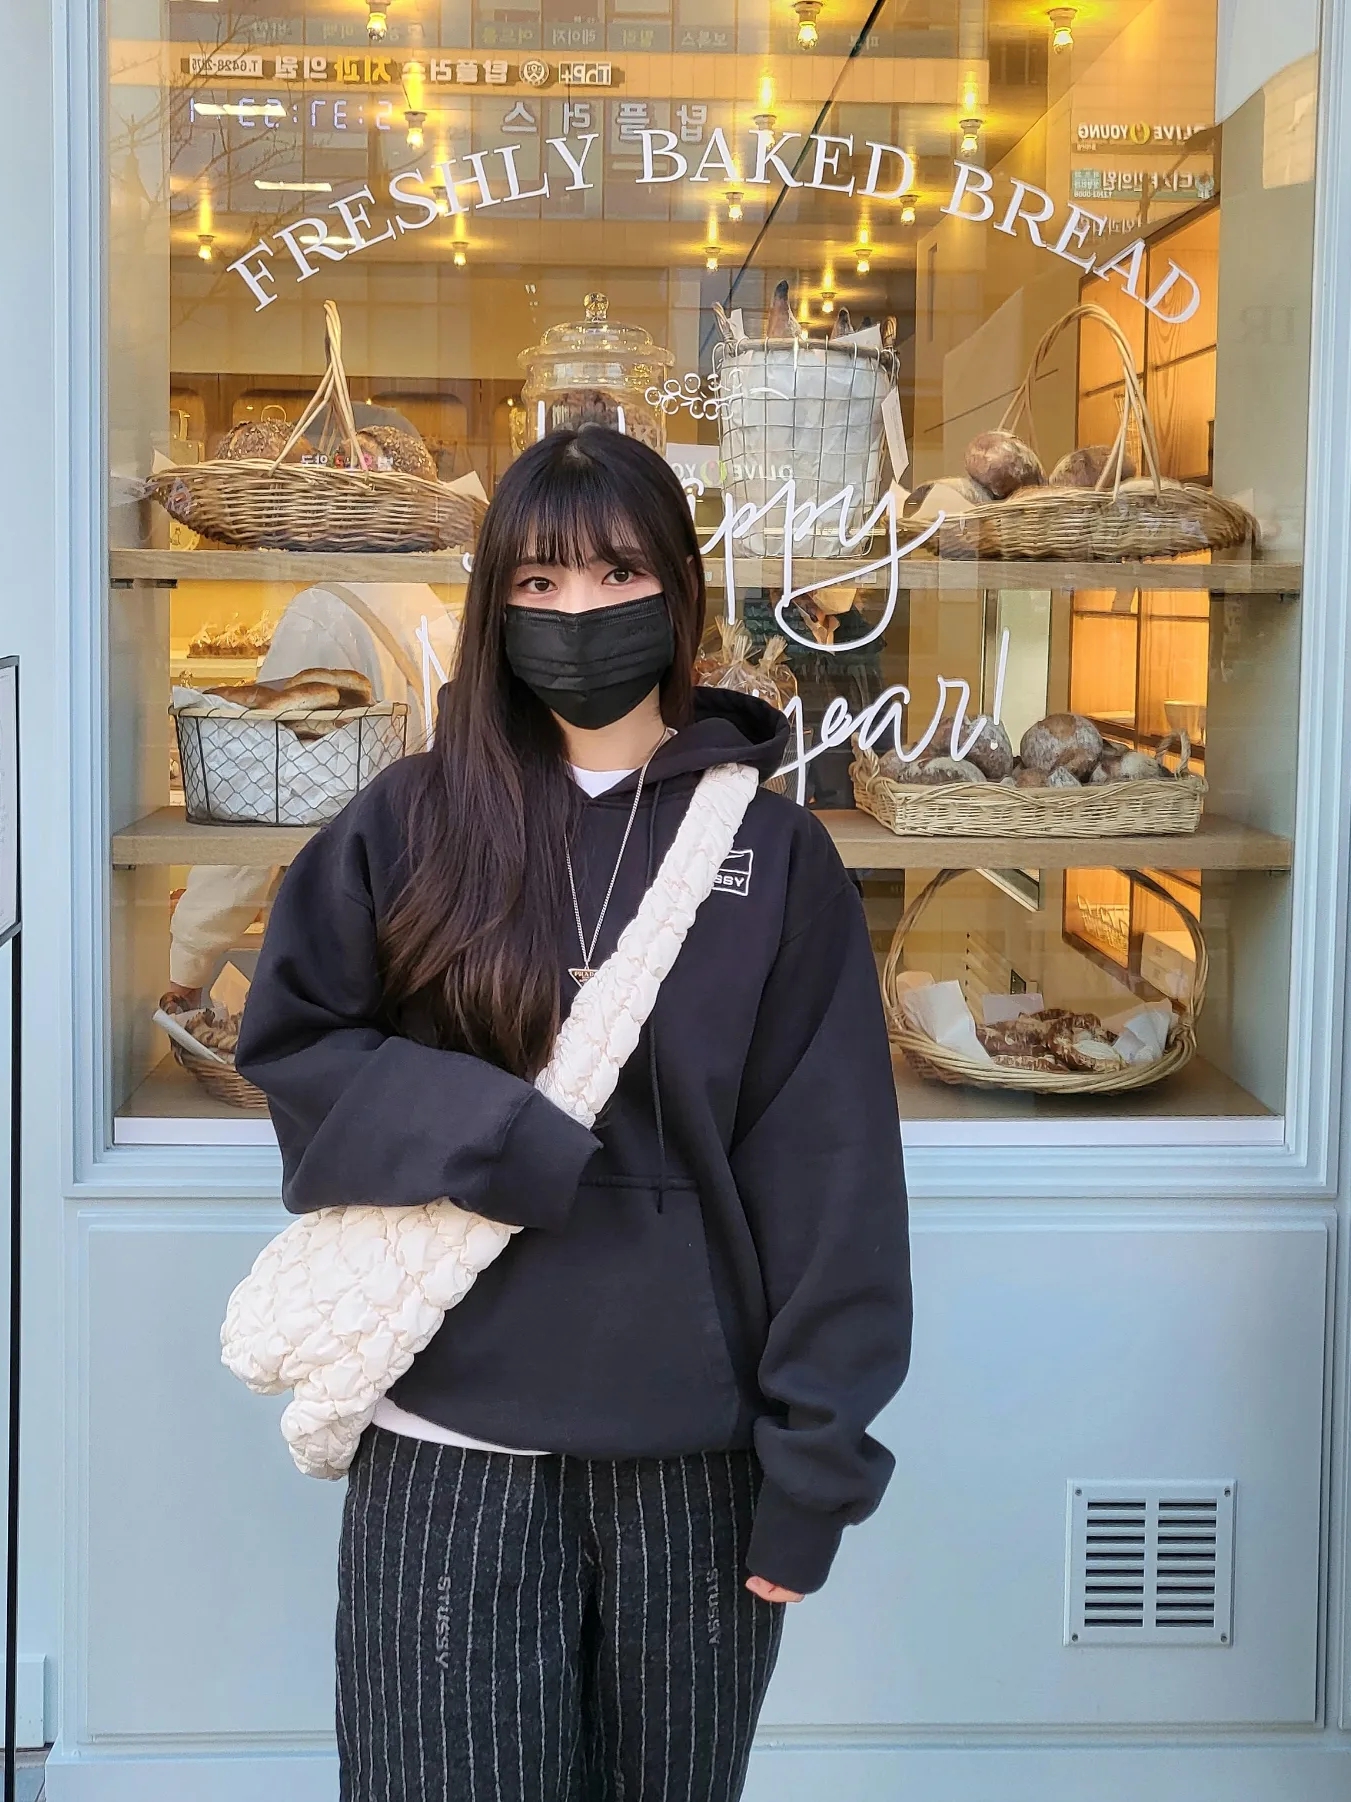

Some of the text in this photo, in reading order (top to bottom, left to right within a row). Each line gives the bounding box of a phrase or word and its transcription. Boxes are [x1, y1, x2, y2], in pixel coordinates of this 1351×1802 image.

[226, 127, 1202, 325] FRESHLY BAKED BREAD
[686, 476, 946, 653] ppy
[713, 874, 745, 887] SSY
